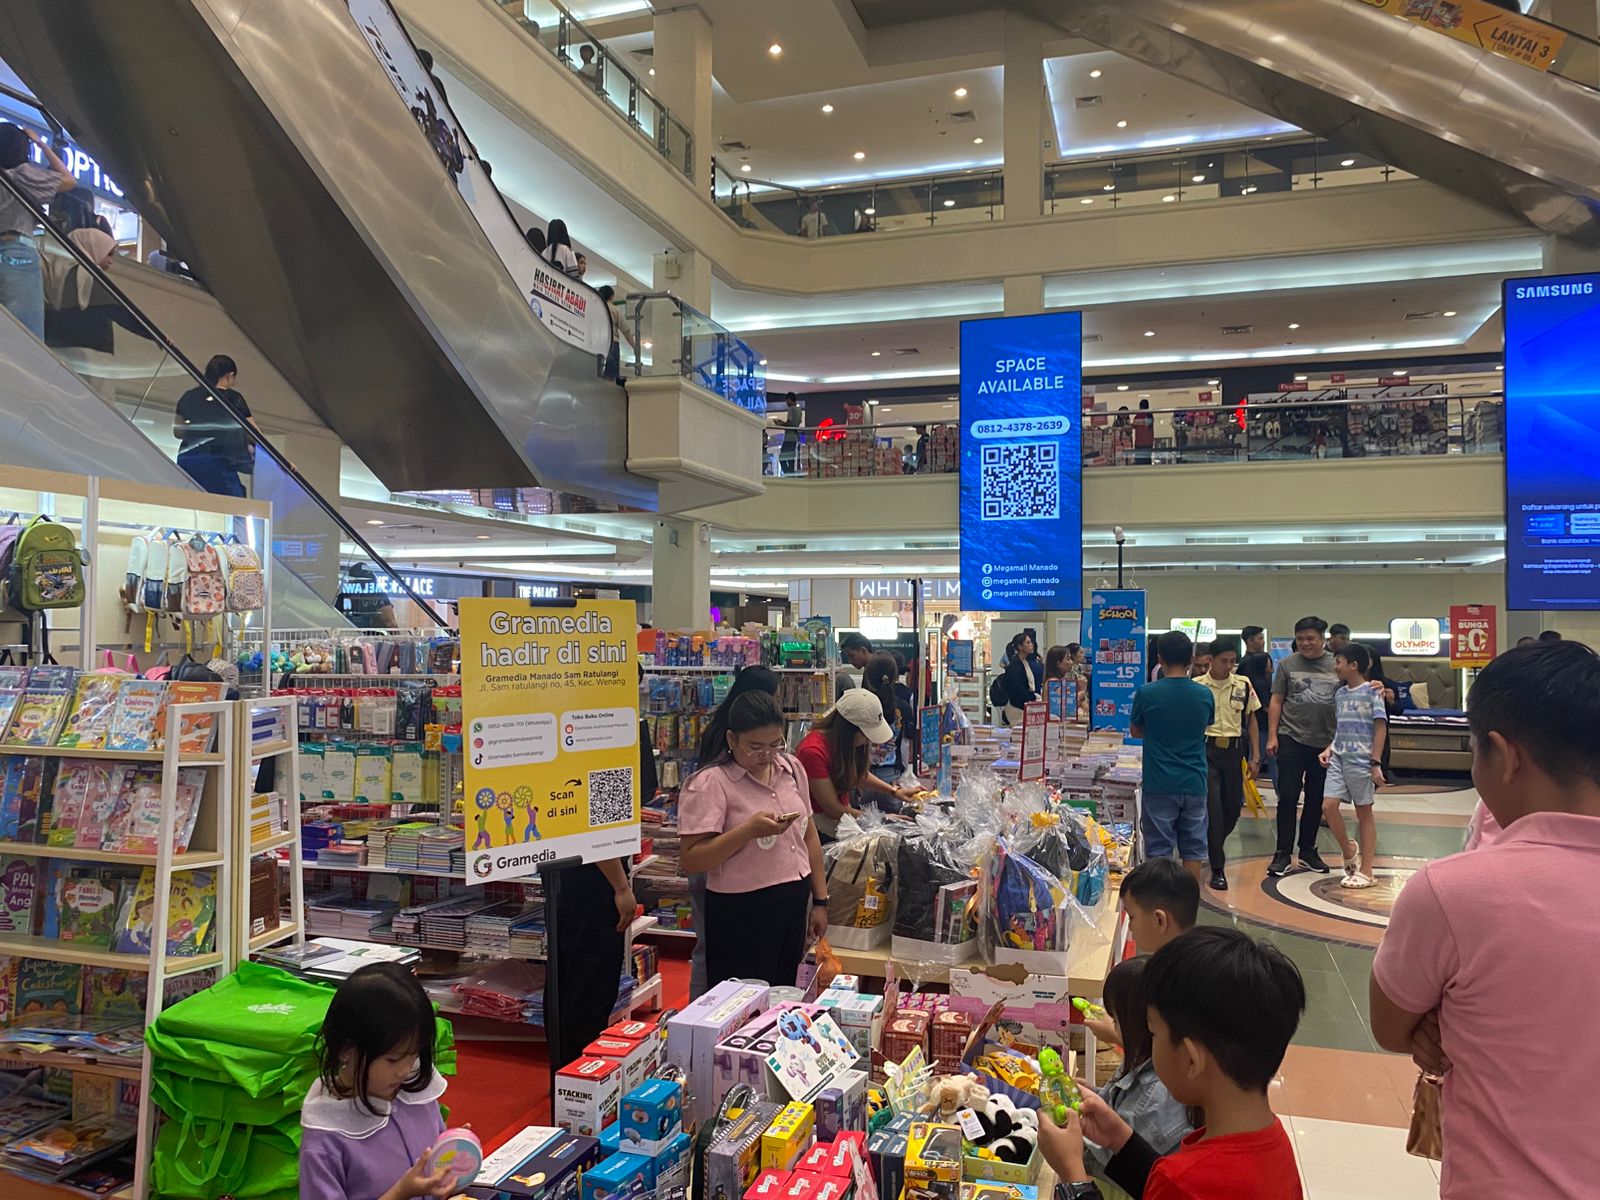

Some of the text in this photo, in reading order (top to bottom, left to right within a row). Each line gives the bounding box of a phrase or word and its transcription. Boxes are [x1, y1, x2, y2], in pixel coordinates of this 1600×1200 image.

[1490, 27, 1538, 53] LANTAI
[1539, 45, 1550, 58] 3
[1516, 282, 1594, 300] SAMSUNG
[995, 356, 1046, 373] SPACE
[977, 375, 1064, 395] AVAILABLE
[977, 420, 1063, 434] 0812-4378-2639
[993, 563, 1059, 573] Megamall Manado
[993, 576, 1060, 586] megamall_manado
[518, 585, 558, 598] THE PALACE
[993, 589, 1056, 598] megamallmanado
[1098, 607, 1139, 620] SCHOOL
[489, 610, 613, 635] Gramedia
[1458, 621, 1489, 629] BUNGA
[1173, 624, 1214, 635] Proclla
[1394, 640, 1436, 649] OLYMPIC
[480, 639, 628, 668] hadir di sini
[485, 669, 619, 683] Gramedia Manado Sam Ratulangi
[490, 682, 510, 691] Sam
[511, 680, 548, 691] ratulangi
[578, 678, 595, 687] Kec.
[597, 678, 626, 687] Wenang
[550, 789, 574, 801] Scan
[547, 804, 577, 818] di sini
[496, 849, 557, 869] Gramedia
[557, 1088, 593, 1101] STACKING
